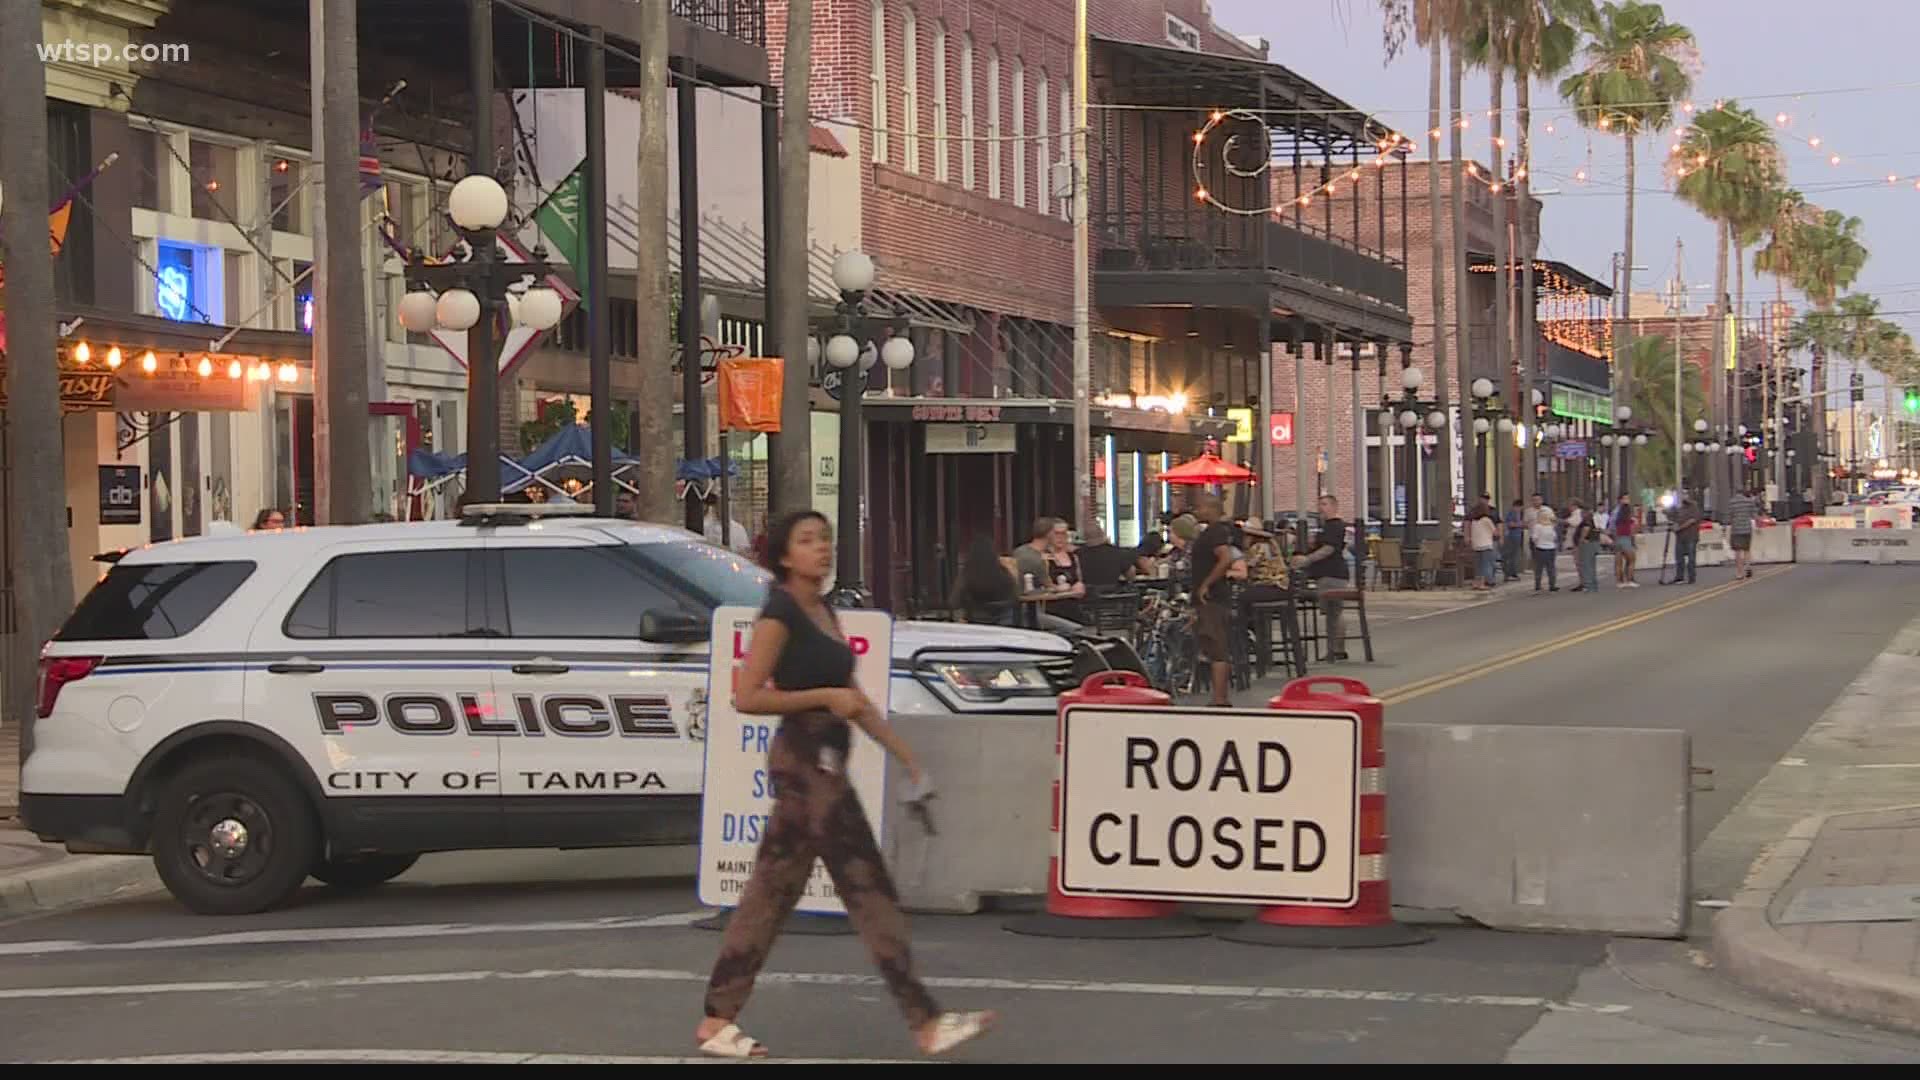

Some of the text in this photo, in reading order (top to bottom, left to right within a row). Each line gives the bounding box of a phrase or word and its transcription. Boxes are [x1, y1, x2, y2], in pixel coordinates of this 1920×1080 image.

[60, 376, 112, 400] asy
[312, 692, 680, 739] POLICE
[1125, 736, 1292, 794] ROAD
[328, 772, 666, 790] CITY OF TAMPA
[1089, 812, 1327, 873] CLOSED
[717, 860, 753, 874] MAINT
[720, 879, 744, 893] OTH
